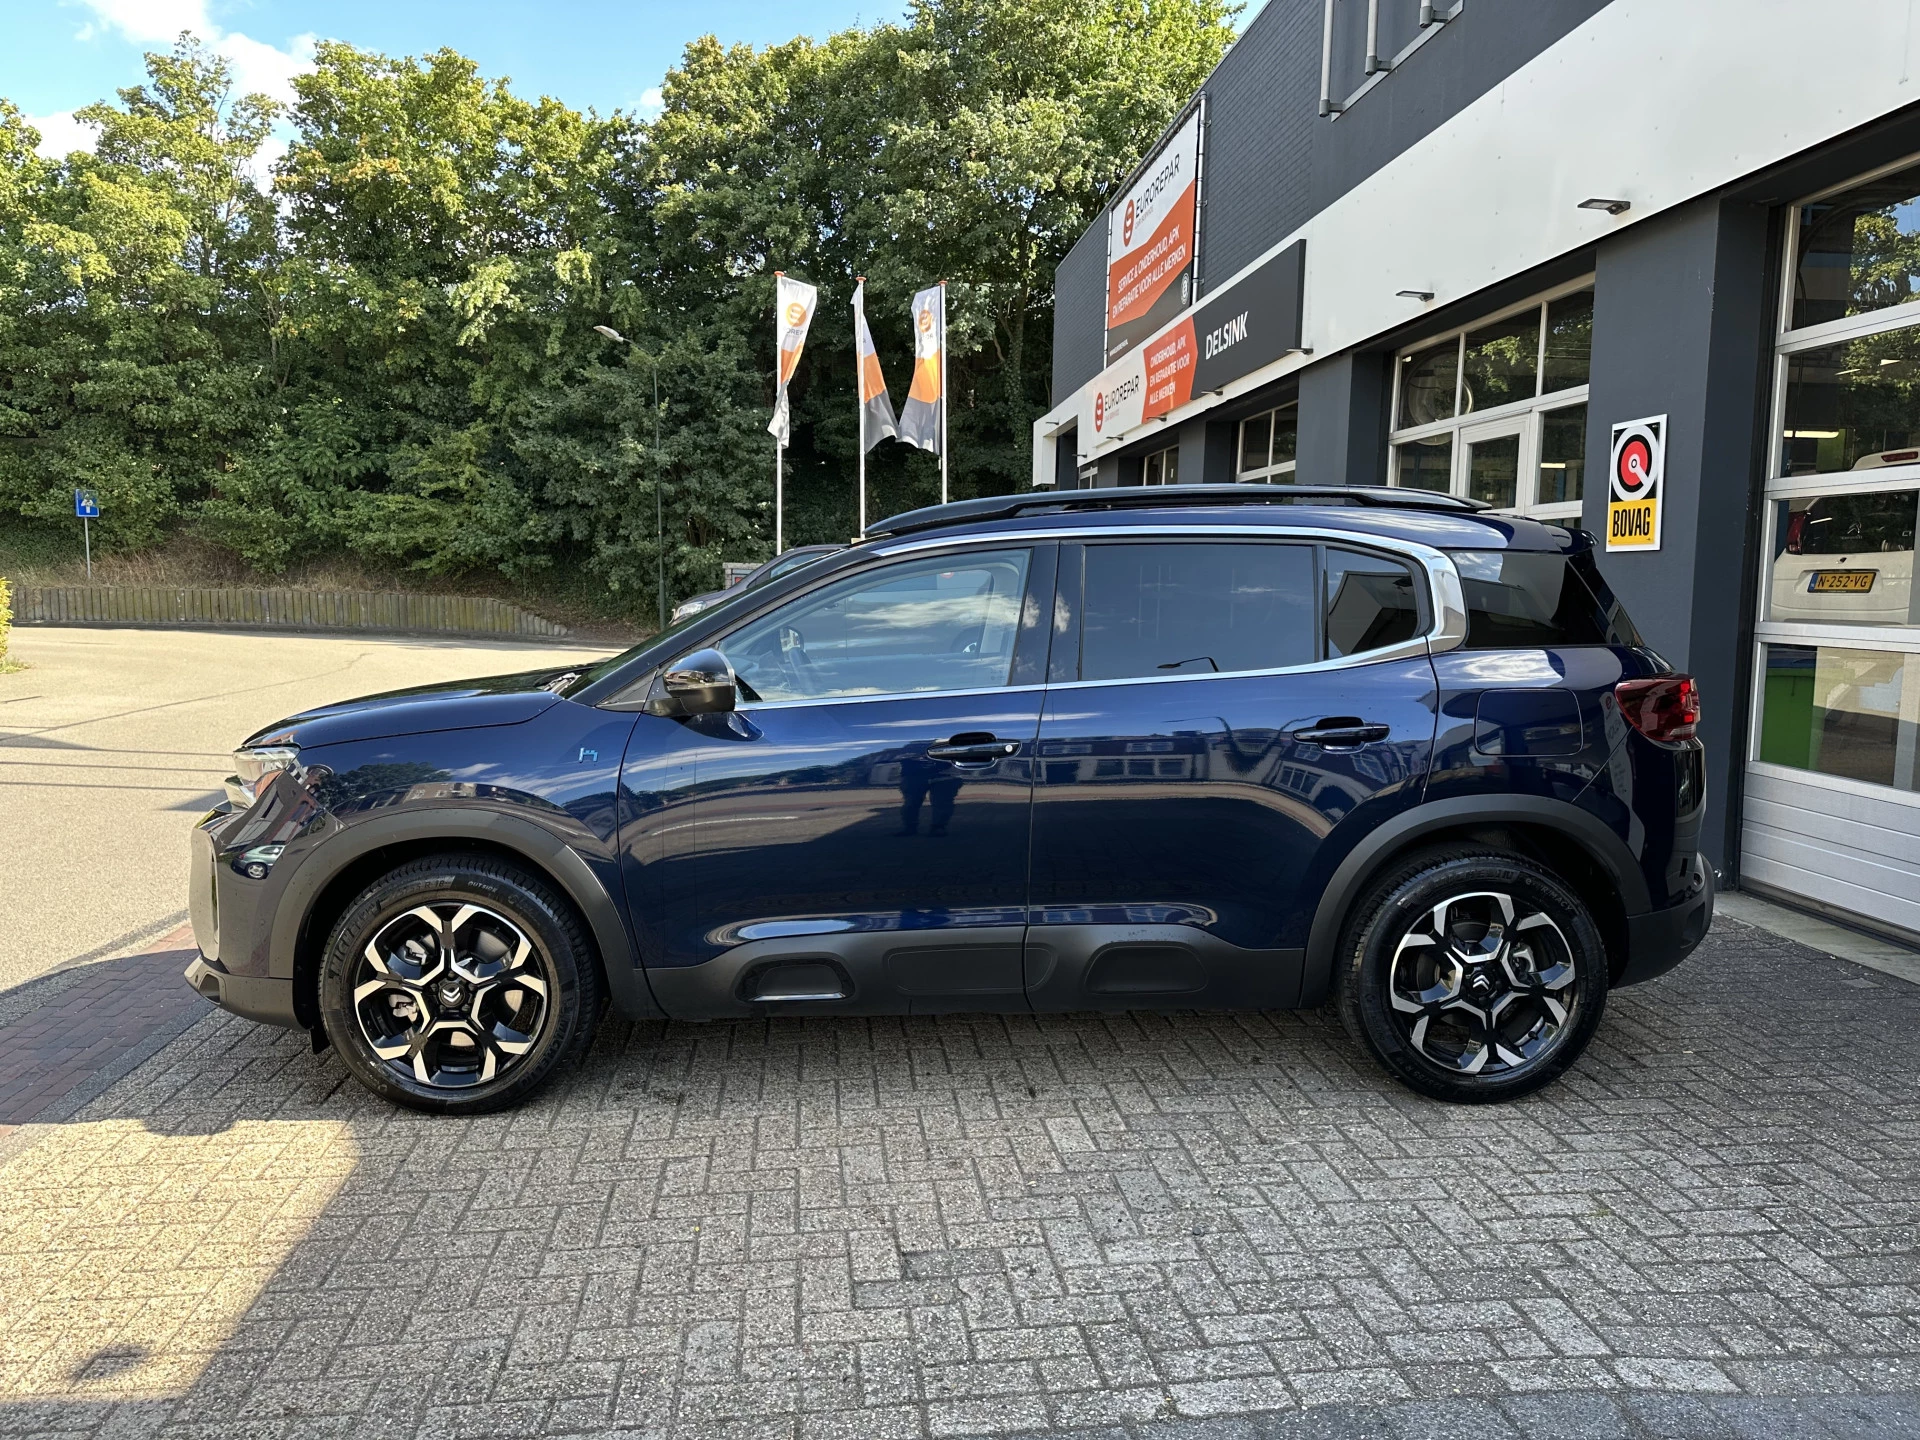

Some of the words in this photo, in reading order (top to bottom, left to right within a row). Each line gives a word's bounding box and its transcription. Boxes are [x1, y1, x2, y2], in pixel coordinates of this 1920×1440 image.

[1135, 153, 1180, 218] EUROREPAR
[1117, 267, 1135, 294] SERVICE
[1168, 223, 1180, 246] APK
[1118, 284, 1139, 312] REPARATIE
[1139, 272, 1152, 295] VOOR
[1151, 262, 1164, 285] ALLE
[1164, 242, 1187, 273] MERKEN
[1177, 334, 1187, 352] APK
[1205, 310, 1249, 360] DELSINK
[1155, 360, 1177, 384] REPARATIE
[1176, 352, 1190, 371] VOOR
[1104, 375, 1140, 412] EUROREPAR
[1612, 507, 1651, 538] BOVAG
[1817, 575, 1869, 588] N-252-VG
